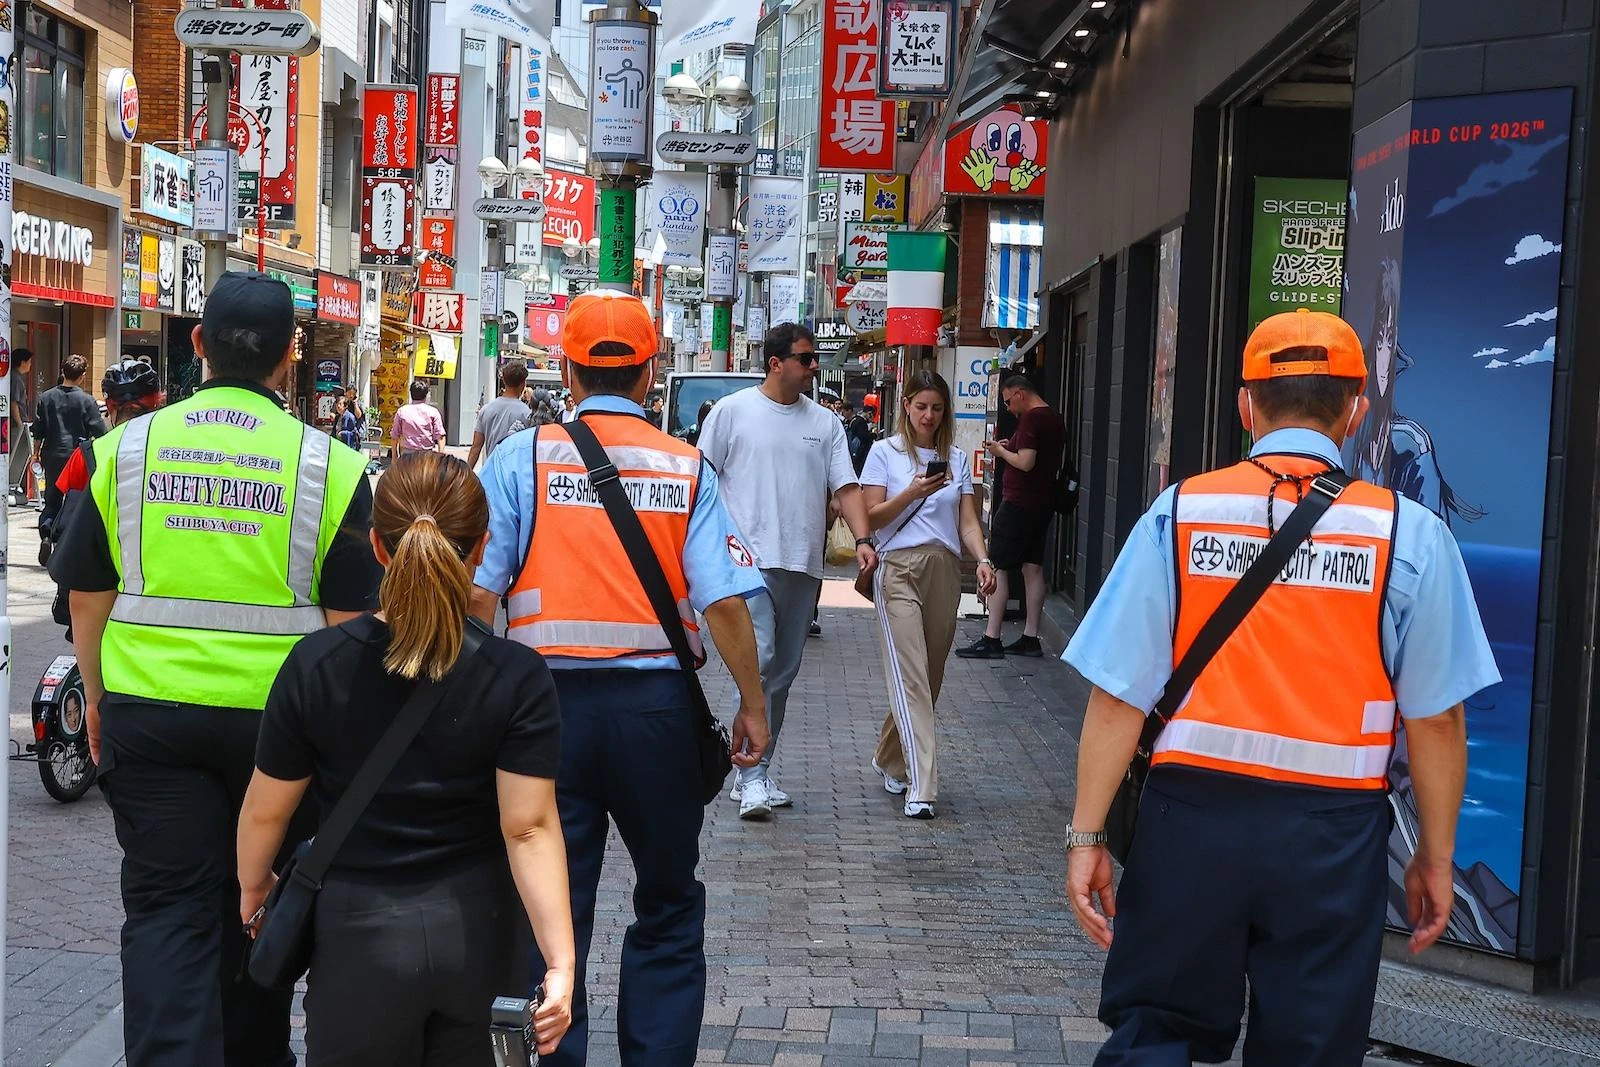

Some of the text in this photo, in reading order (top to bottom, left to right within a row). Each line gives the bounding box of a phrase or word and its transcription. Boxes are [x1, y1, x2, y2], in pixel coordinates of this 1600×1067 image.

[183, 19, 304, 38] 渋谷センター街
[897, 22, 941, 33] 大衆食堂
[464, 41, 485, 52] 3637
[900, 34, 936, 50] てんぐ
[891, 48, 943, 66] 大ホール
[440, 77, 456, 144] 野郎ラーメン
[373, 113, 389, 166] お好み焼
[1450, 126, 1482, 143] CUP
[662, 139, 750, 155] 渋谷センター街
[756, 154, 774, 162] ABC
[153, 163, 178, 209] 麻雀
[434, 168, 444, 205] カンダヤ
[873, 189, 897, 210] 松
[477, 204, 541, 215] 渋谷センター街
[764, 204, 788, 216] 渋谷
[549, 217, 583, 240] ECHO
[658, 220, 699, 233] Sunday
[753, 217, 797, 229] おとなり
[1282, 218, 1317, 227] HANDS
[54, 221, 93, 267] KING
[752, 232, 797, 243] サンデー
[421, 293, 461, 330] 豚
[184, 409, 264, 432] SECURITY
[159, 448, 282, 471] 渋谷区喫煙ルール啓発員
[147, 473, 287, 515] SAFETY PATROL
[650, 483, 686, 508] PATROL
[166, 517, 262, 535] SHIBUYA CITY
[1286, 548, 1315, 581] CITY
[1321, 551, 1370, 585] PATROL
